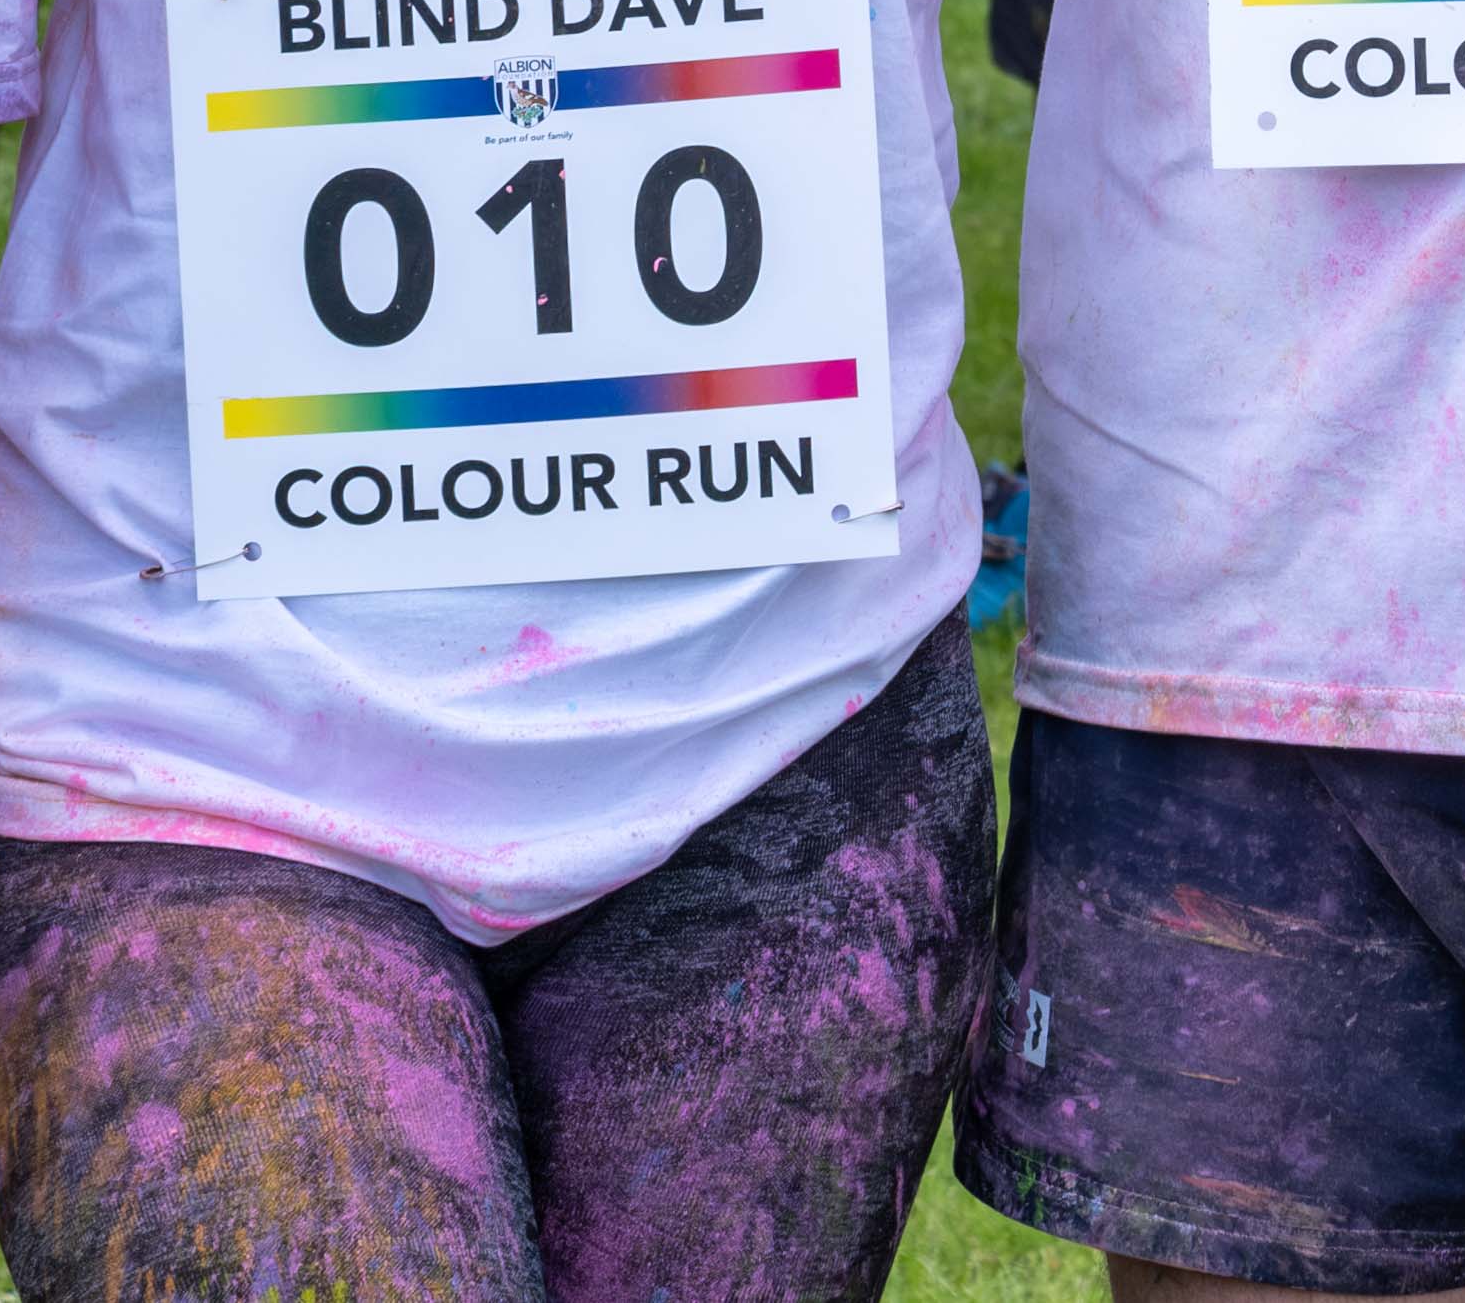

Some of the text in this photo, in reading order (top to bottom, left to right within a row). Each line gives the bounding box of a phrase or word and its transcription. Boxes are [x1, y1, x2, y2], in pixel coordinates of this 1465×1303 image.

[498, 59, 552, 73] ALBION
[484, 136, 496, 144] Be
[498, 134, 516, 144] part
[519, 134, 529, 142] of
[548, 131, 573, 140] family
[304, 146, 762, 347] 010
[275, 437, 814, 528] COLOUR RUN
